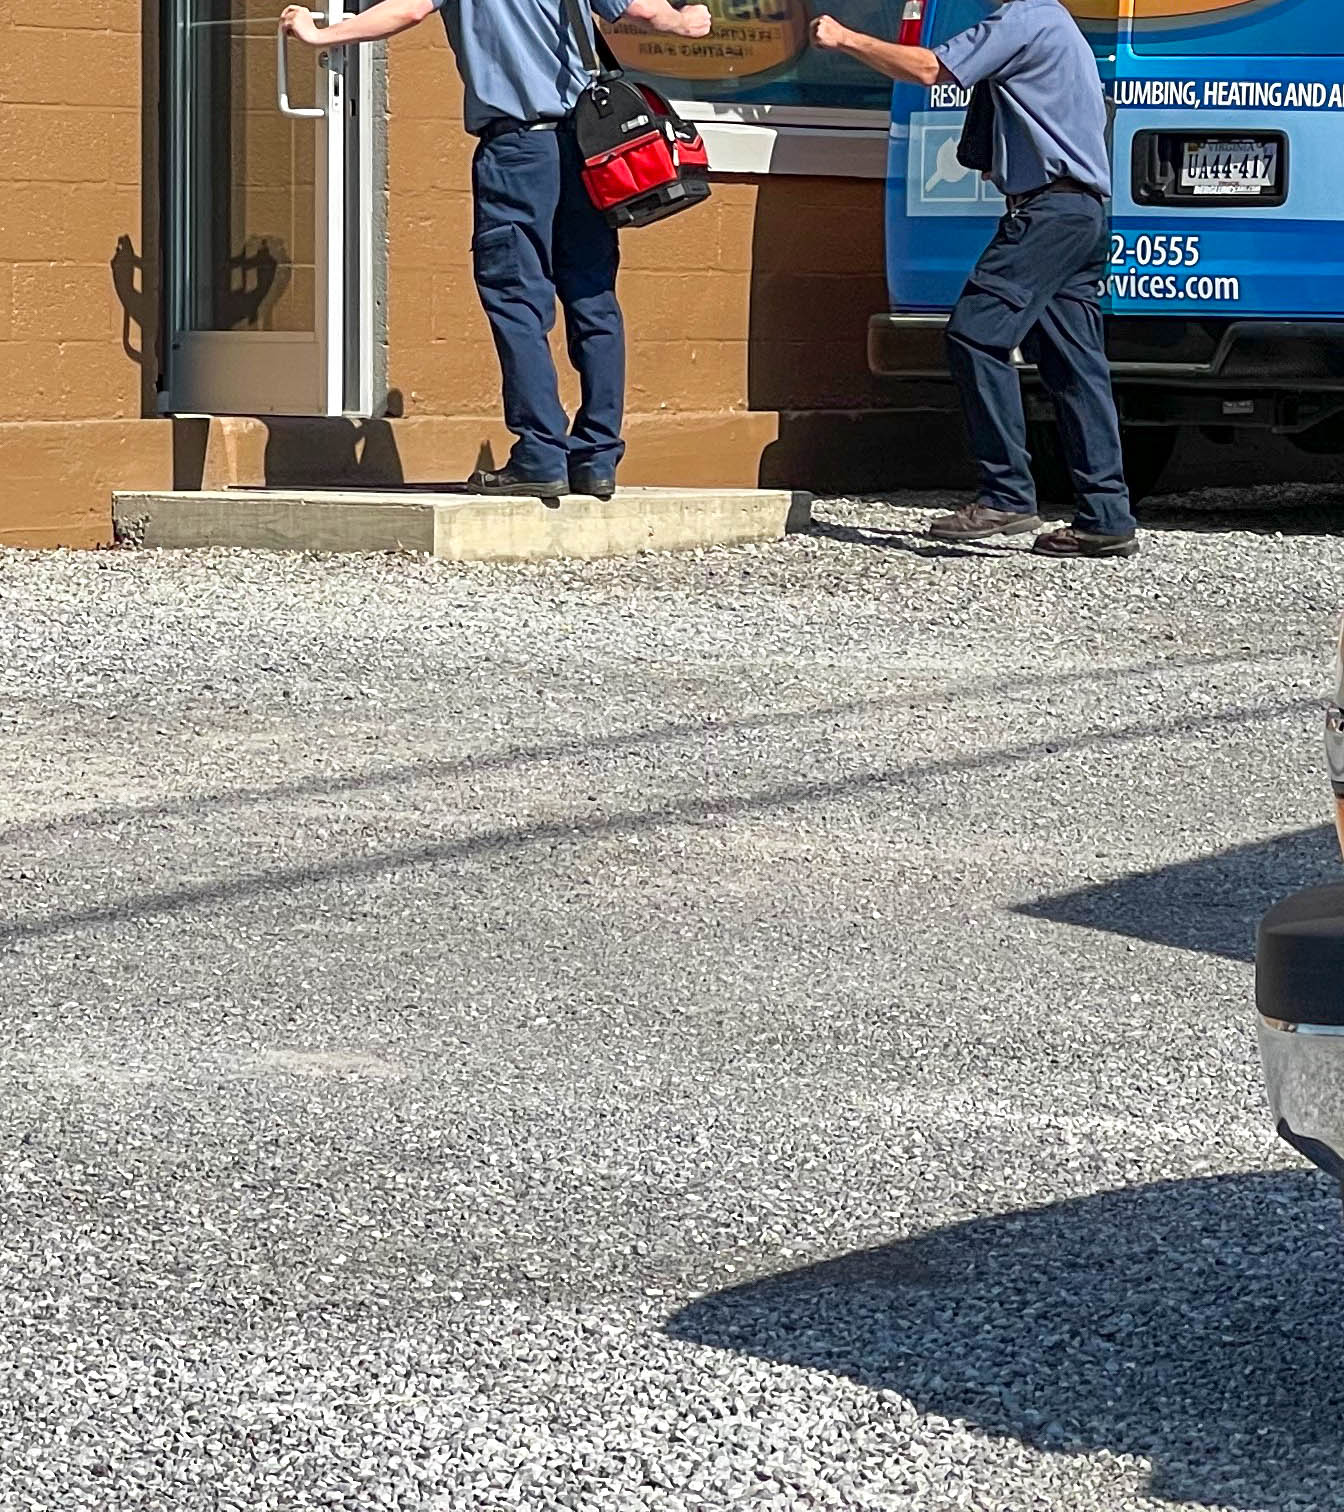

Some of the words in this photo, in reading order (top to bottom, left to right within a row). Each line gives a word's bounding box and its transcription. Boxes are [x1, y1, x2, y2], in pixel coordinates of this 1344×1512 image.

[1114, 81, 1201, 109] LUMBING,
[1203, 81, 1282, 107] HEATING
[1284, 83, 1326, 107] AND
[1107, 235, 1199, 266] 2-0555
